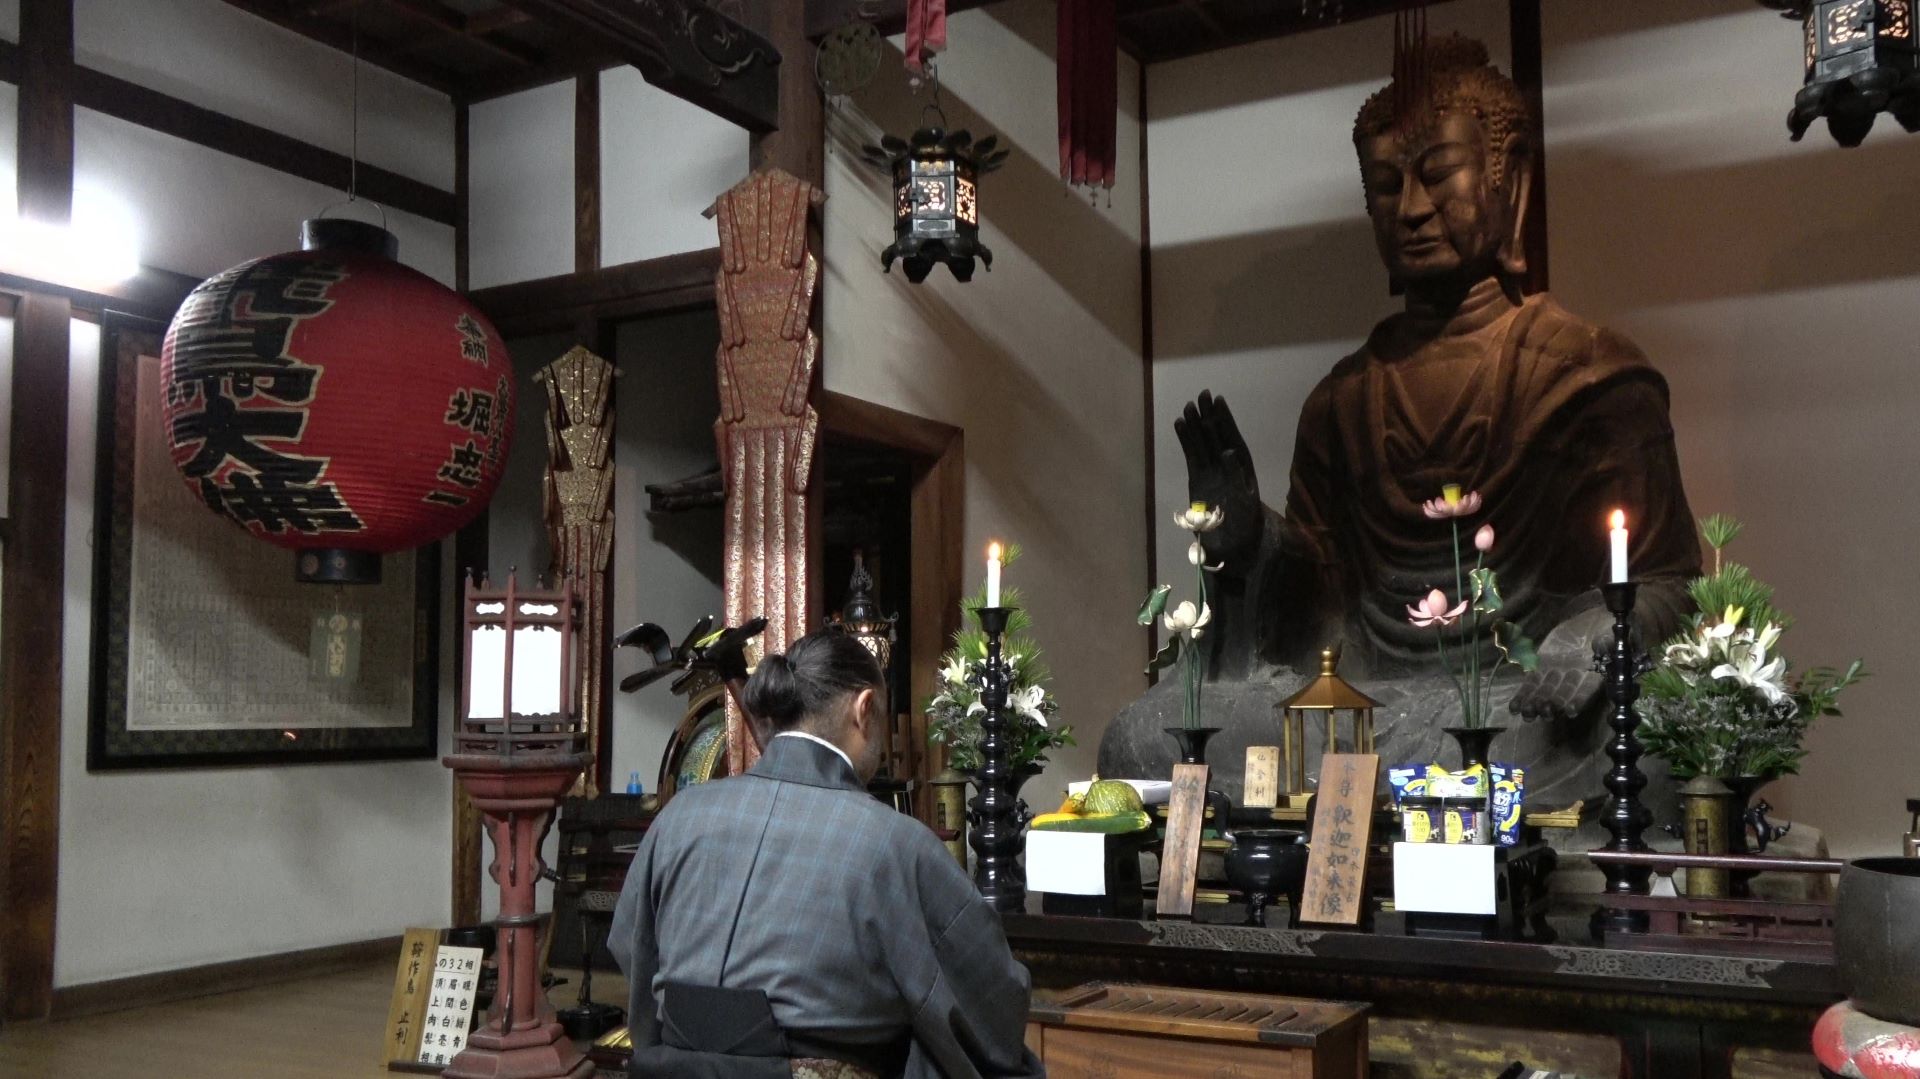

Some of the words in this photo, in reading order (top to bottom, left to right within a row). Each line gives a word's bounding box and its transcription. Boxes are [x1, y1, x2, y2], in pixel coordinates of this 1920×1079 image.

[455, 313, 489, 368] 奉納
[422, 388, 494, 507] 堀忠一
[435, 958, 474, 970] の32相
